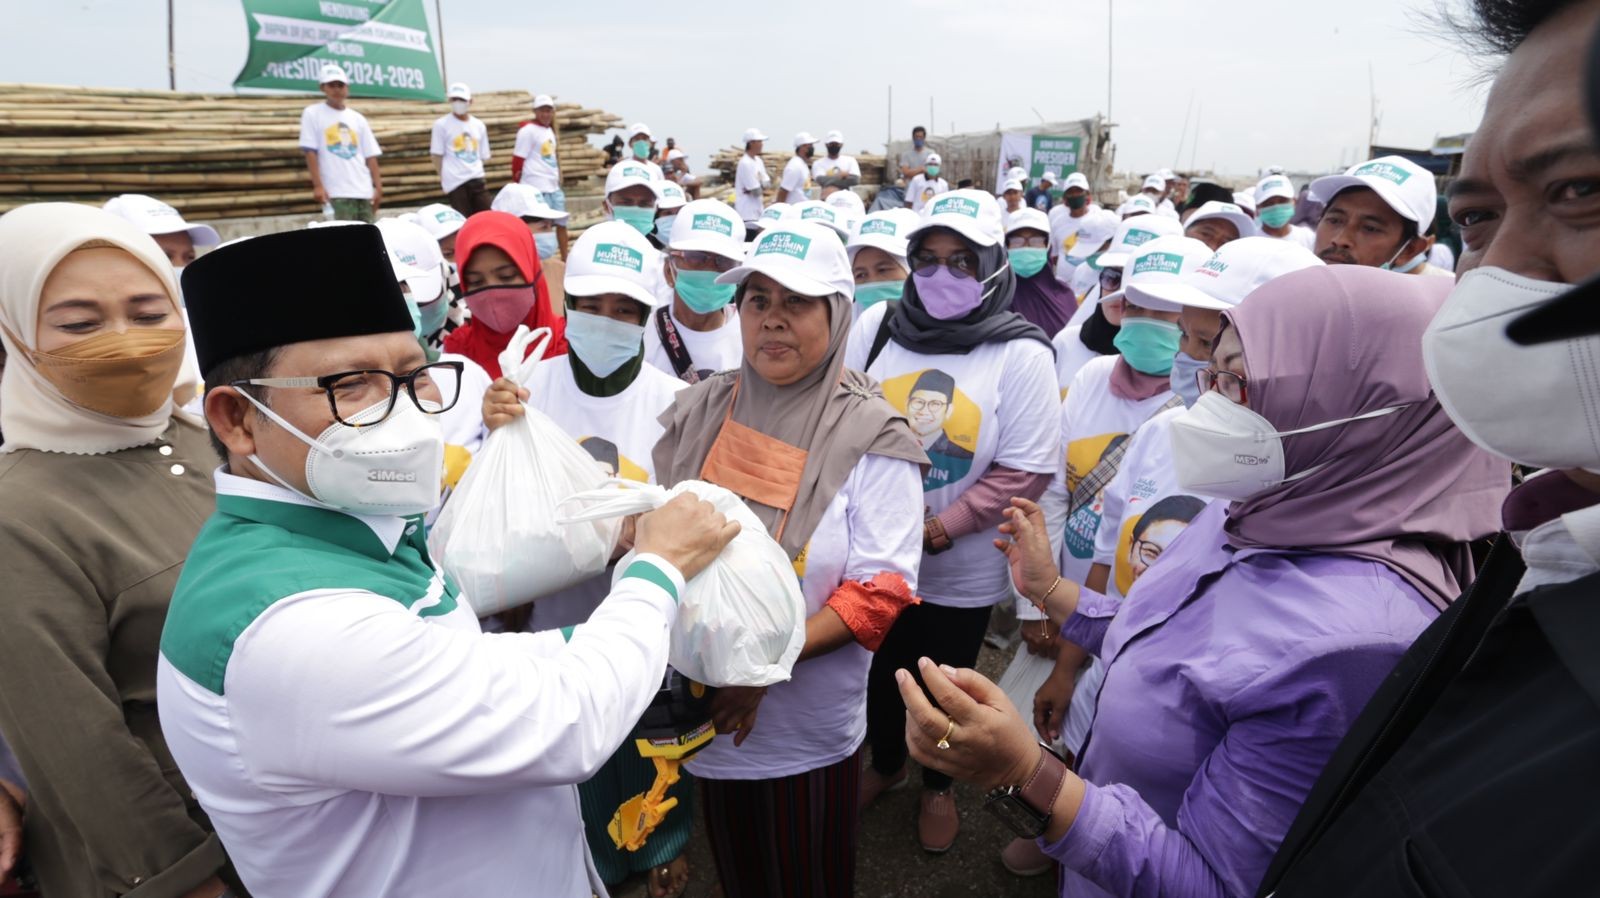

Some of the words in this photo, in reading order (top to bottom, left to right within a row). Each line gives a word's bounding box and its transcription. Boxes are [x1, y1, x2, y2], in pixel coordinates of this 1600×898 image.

[344, 61, 425, 90] 2024-2029
[1034, 151, 1076, 165] PRESIDEN
[772, 234, 792, 242] GUS
[611, 246, 629, 256] GUS
[1077, 509, 1097, 529] GUS
